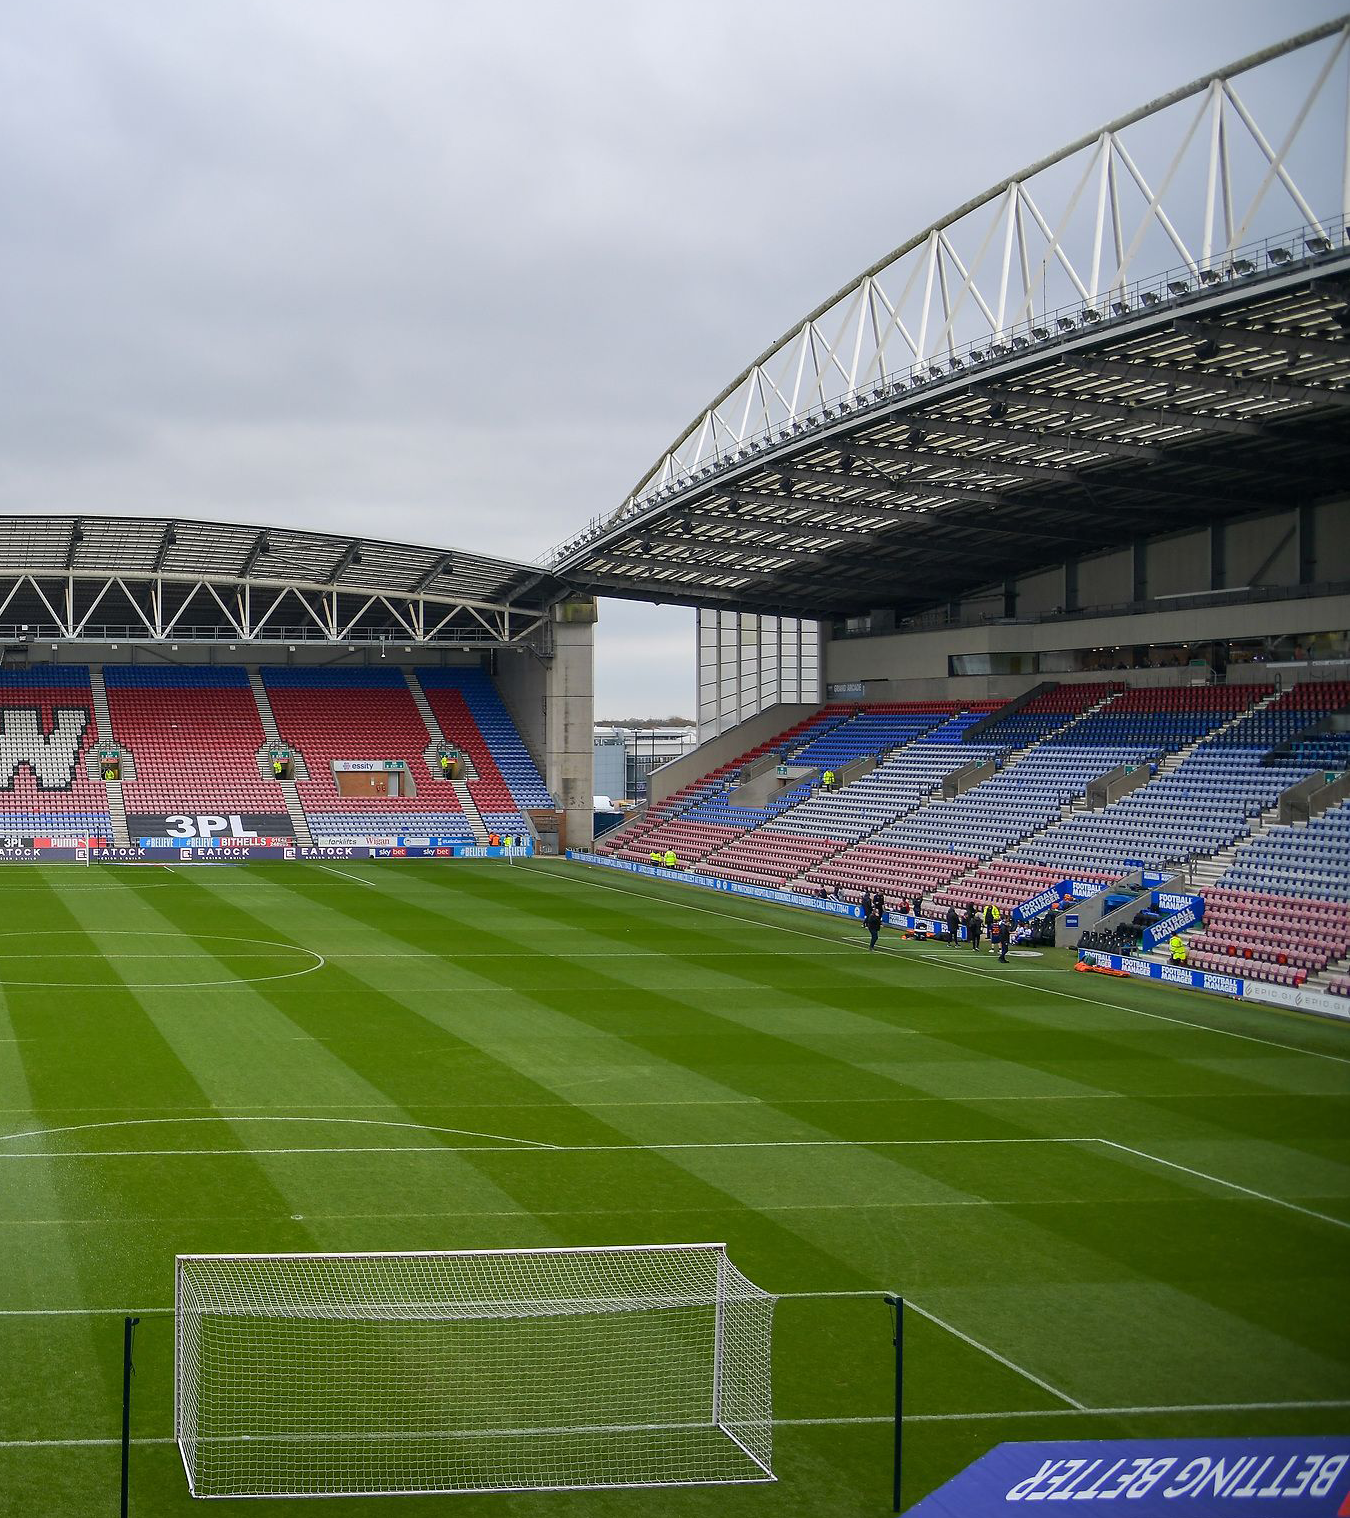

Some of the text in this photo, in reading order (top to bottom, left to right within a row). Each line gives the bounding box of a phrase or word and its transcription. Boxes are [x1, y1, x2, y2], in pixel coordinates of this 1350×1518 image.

[352, 762, 374, 770] essity
[165, 815, 258, 838] 3PL
[4, 838, 24, 848] 3PL
[51, 838, 78, 848] PUMA
[146, 838, 173, 847] #BELIEVE
[186, 838, 213, 847] #BELIEVE
[221, 838, 267, 846] BITHELLS
[93, 848, 146, 856] EATOCK
[197, 848, 250, 856] EATOCK
[301, 847, 353, 855] EATOCK
[379, 848, 391, 856] sky
[423, 848, 436, 856] sky
[460, 846, 488, 857] #BELIEVE
[500, 846, 527, 857] #BELIEVE
[1072, 882, 1101, 892] FOOTBALL
[1019, 886, 1058, 914] FOOTBALL
[1158, 893, 1193, 904] FOOTBALL
[1021, 893, 1060, 919] MANAGER
[1151, 907, 1193, 934] FOOTBALL
[1153, 913, 1195, 941] MANAGER
[1085, 951, 1111, 962] FOOTBALL
[1121, 958, 1150, 969] FOOTBALL
[1121, 964, 1150, 976] MANAGER
[1161, 966, 1193, 977] FOOTBALL
[1161, 972, 1193, 985] MANAGER
[1203, 974, 1237, 986] FOOTBALL
[1203, 981, 1237, 994] MANAGER
[1005, 1455, 1349, 1500] BETTING BETTER
